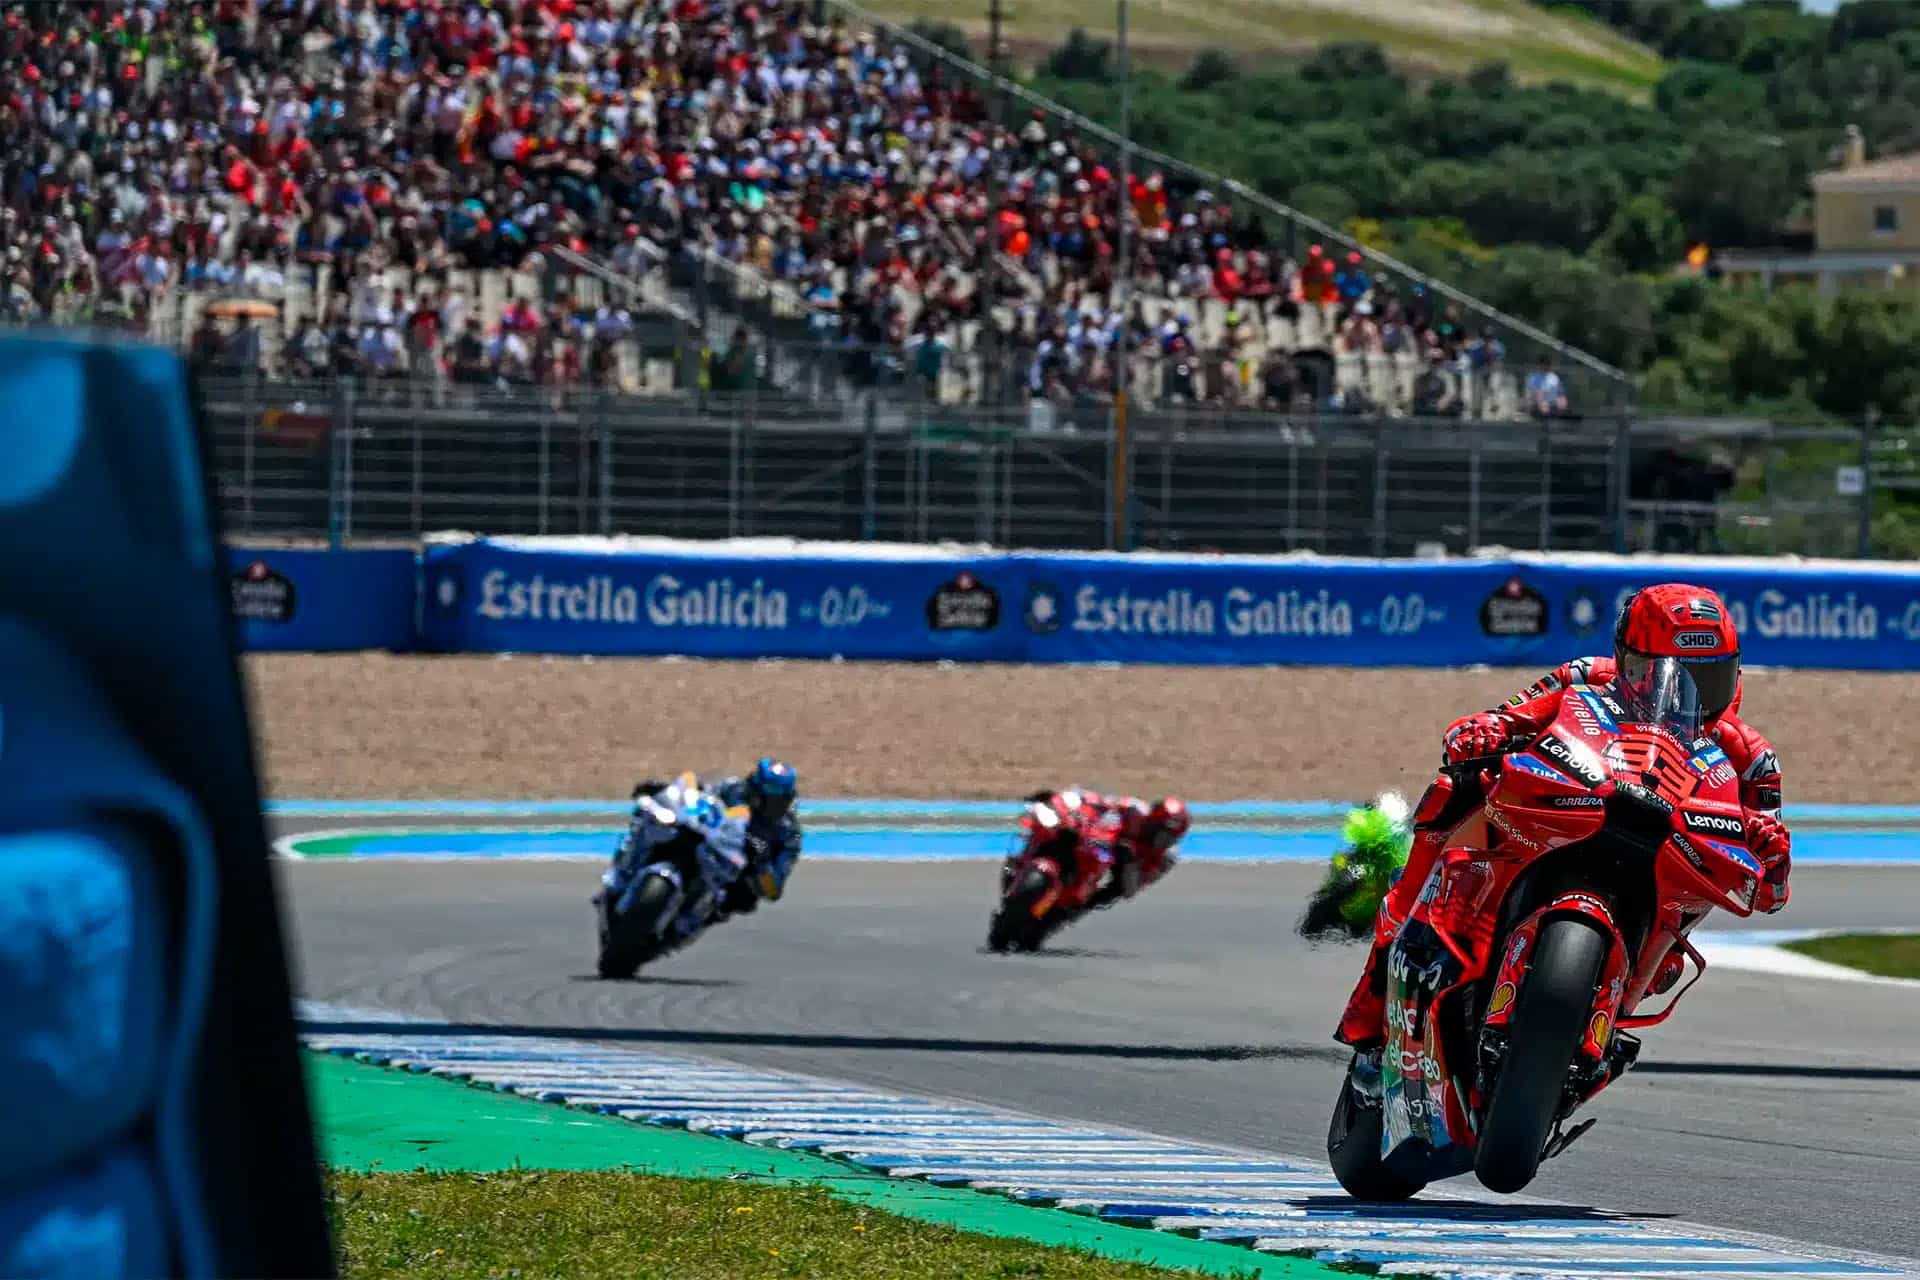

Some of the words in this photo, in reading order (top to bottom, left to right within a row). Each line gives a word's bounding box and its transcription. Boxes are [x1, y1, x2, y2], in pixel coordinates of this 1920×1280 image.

[478, 571, 638, 622] Estrella
[646, 574, 788, 628] Galicia
[1073, 585, 1214, 634] Estrella
[1225, 588, 1352, 636] Galicia
[1757, 589, 1880, 640] Galicia
[1531, 766, 1557, 780] TIM
[1540, 736, 1602, 782] Lenovo
[1554, 797, 1604, 806] CARRERA
[1511, 828, 1539, 852] Sport
[1683, 811, 1742, 833] Lenovo
[1672, 832, 1704, 869] CARRERA
